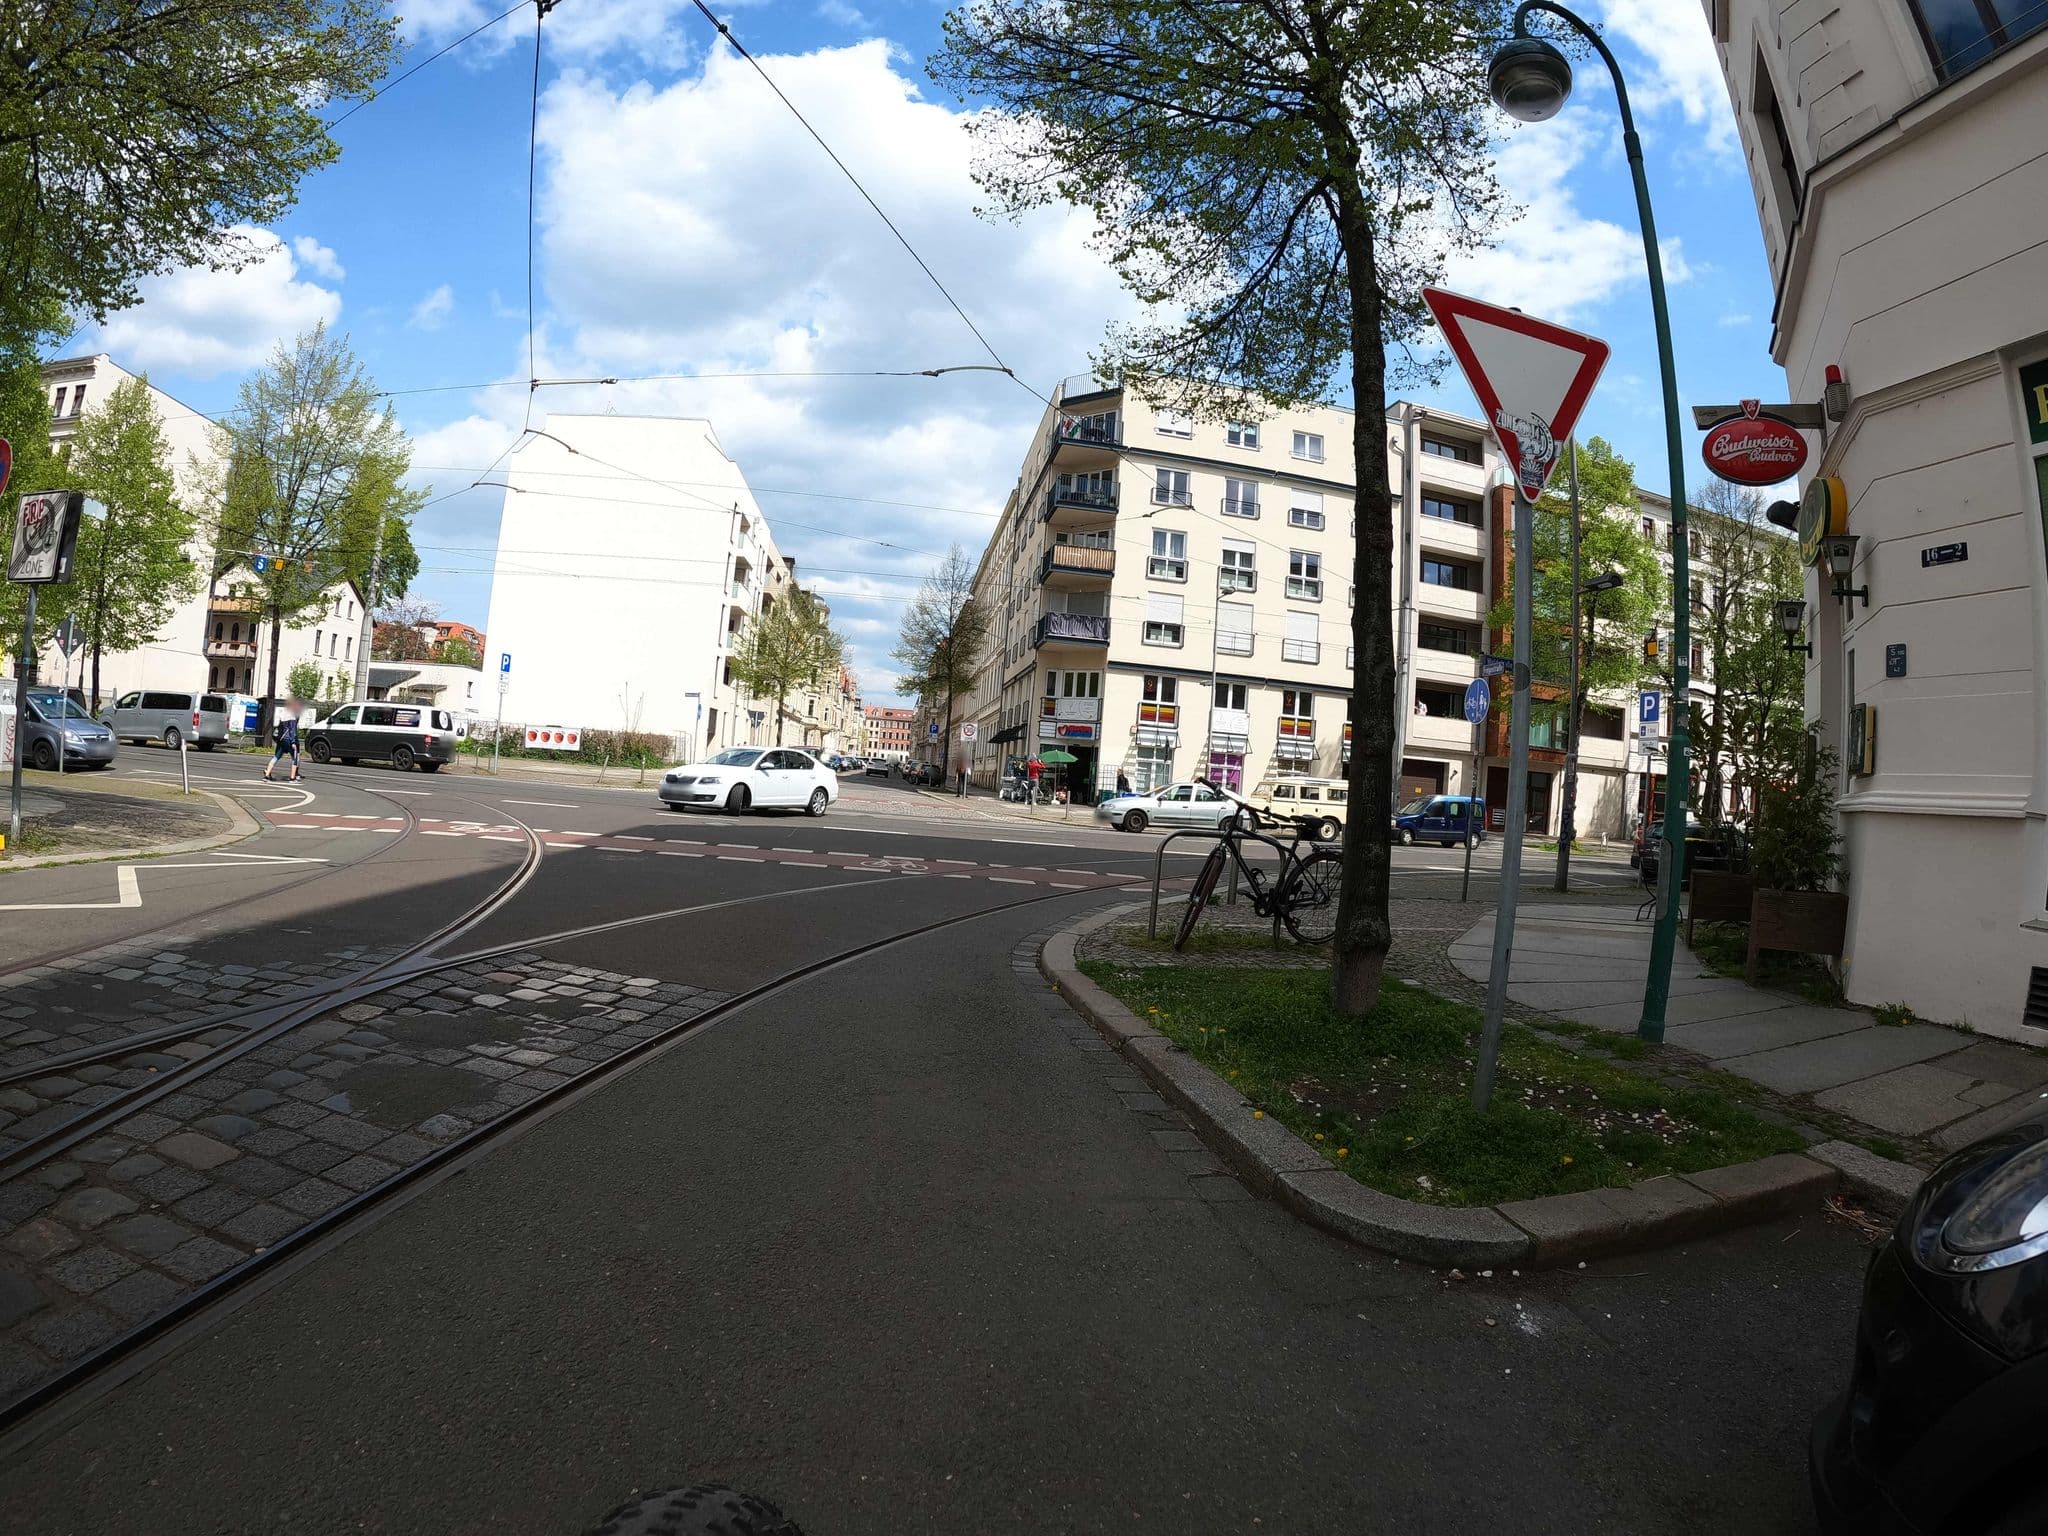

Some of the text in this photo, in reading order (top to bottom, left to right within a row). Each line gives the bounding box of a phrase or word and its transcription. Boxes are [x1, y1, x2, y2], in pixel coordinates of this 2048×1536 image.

[1711, 433, 1799, 461] Budweiser
[19, 559, 45, 575] ZONE
[502, 655, 510, 670] P
[1643, 695, 1656, 719] P
